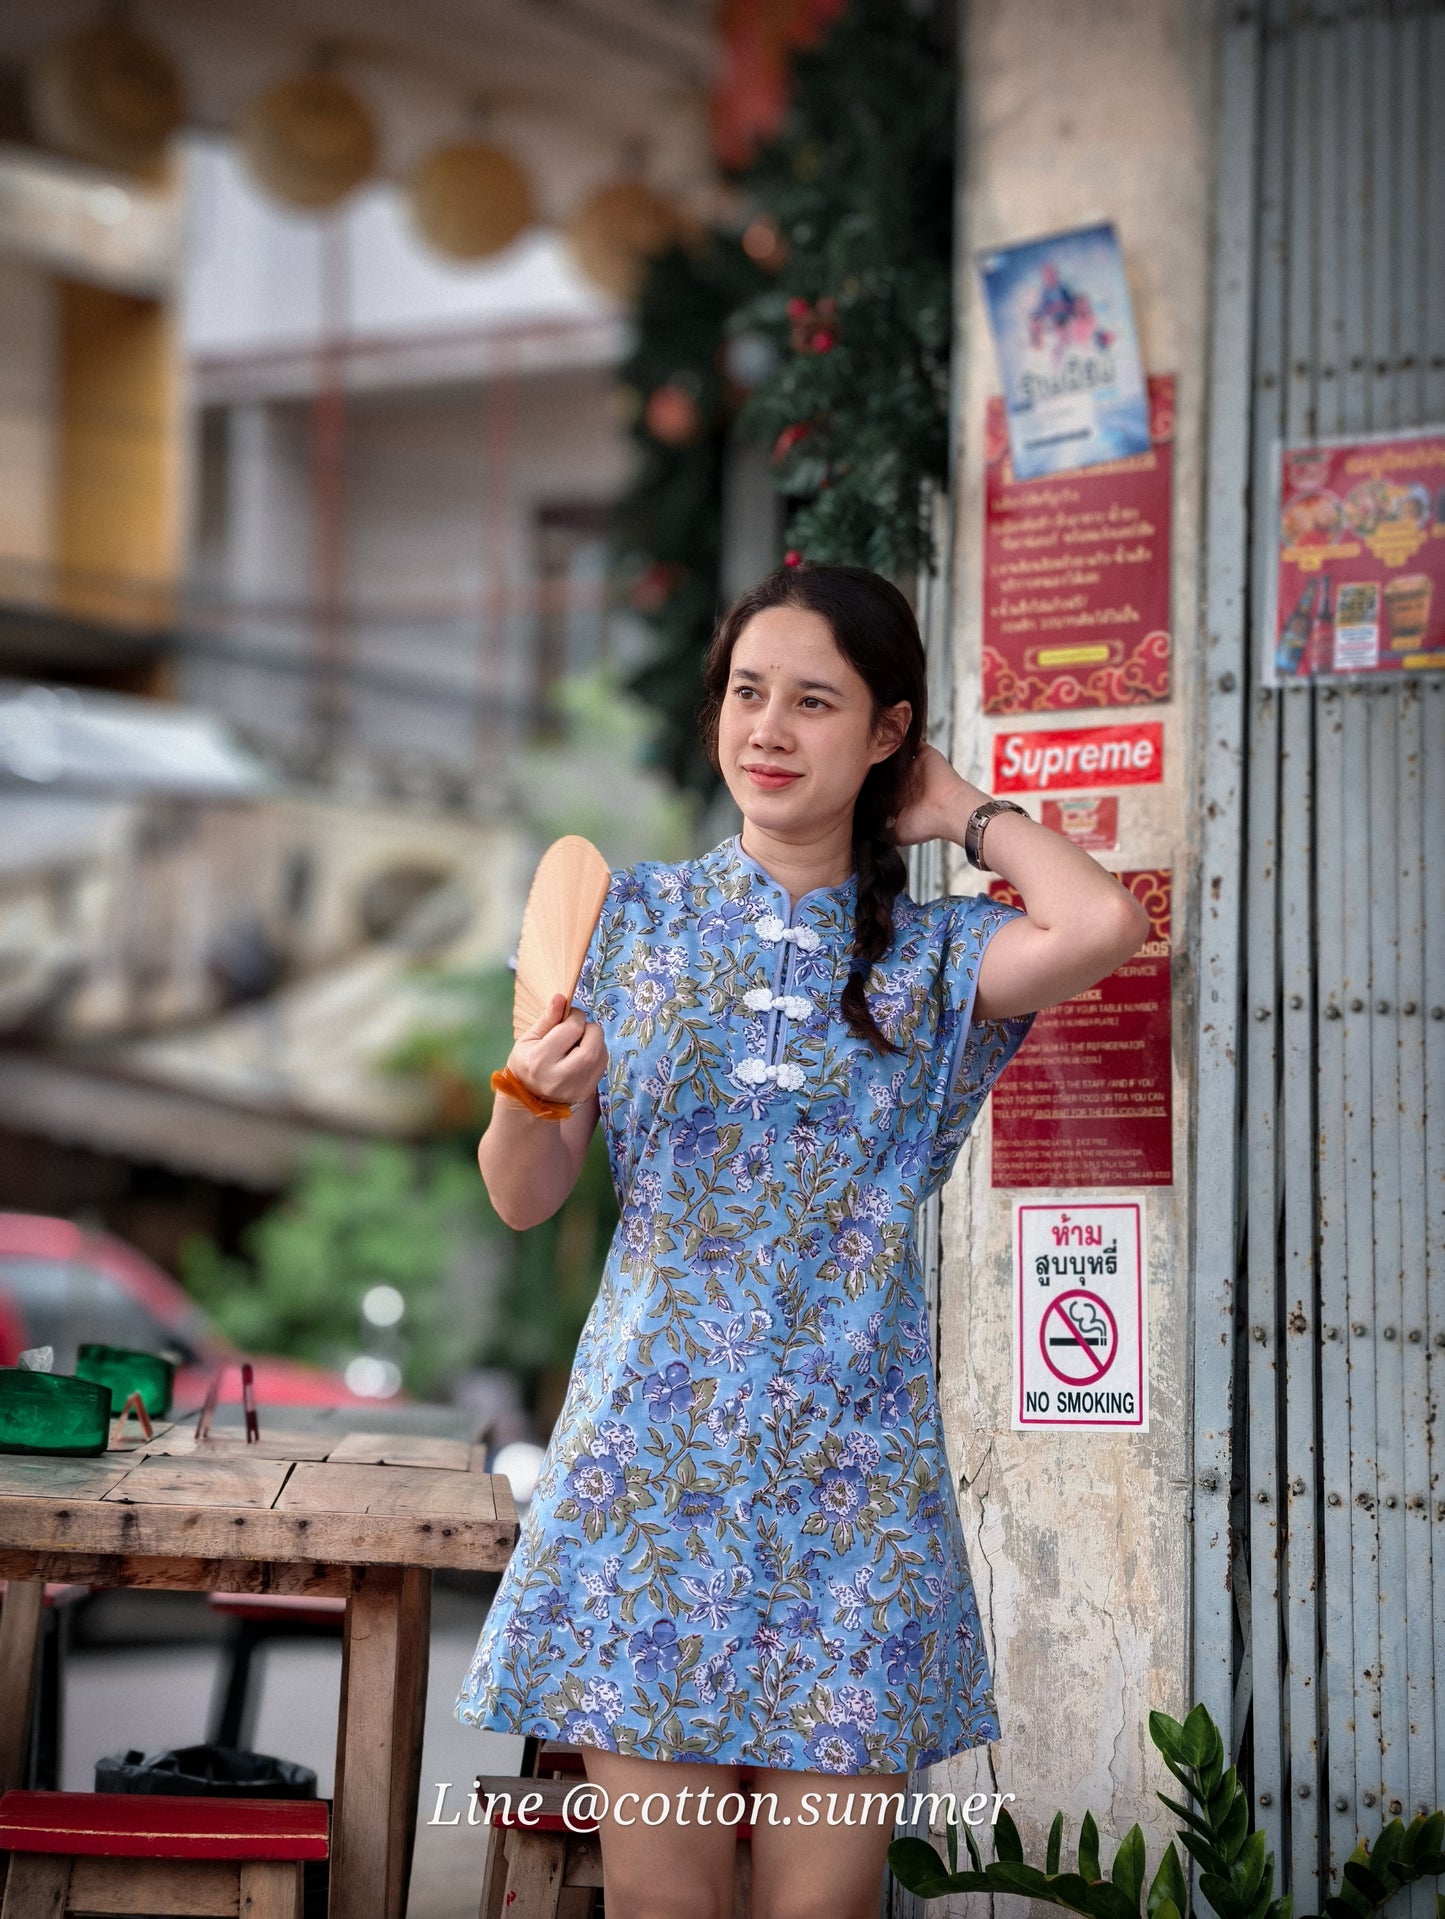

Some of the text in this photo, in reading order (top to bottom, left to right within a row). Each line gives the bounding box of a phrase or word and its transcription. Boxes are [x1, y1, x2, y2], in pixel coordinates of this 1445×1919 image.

[1001, 736, 1153, 787] Supreme
[1113, 1092, 1129, 1102] TEA
[1130, 1092, 1147, 1102] YOU
[1148, 1091, 1165, 1101] CAN
[1051, 1213, 1102, 1246] ห้าม
[1035, 1239, 1117, 1286] สูบบุหรี่
[1026, 1391, 1134, 1414] NO SMOKING
